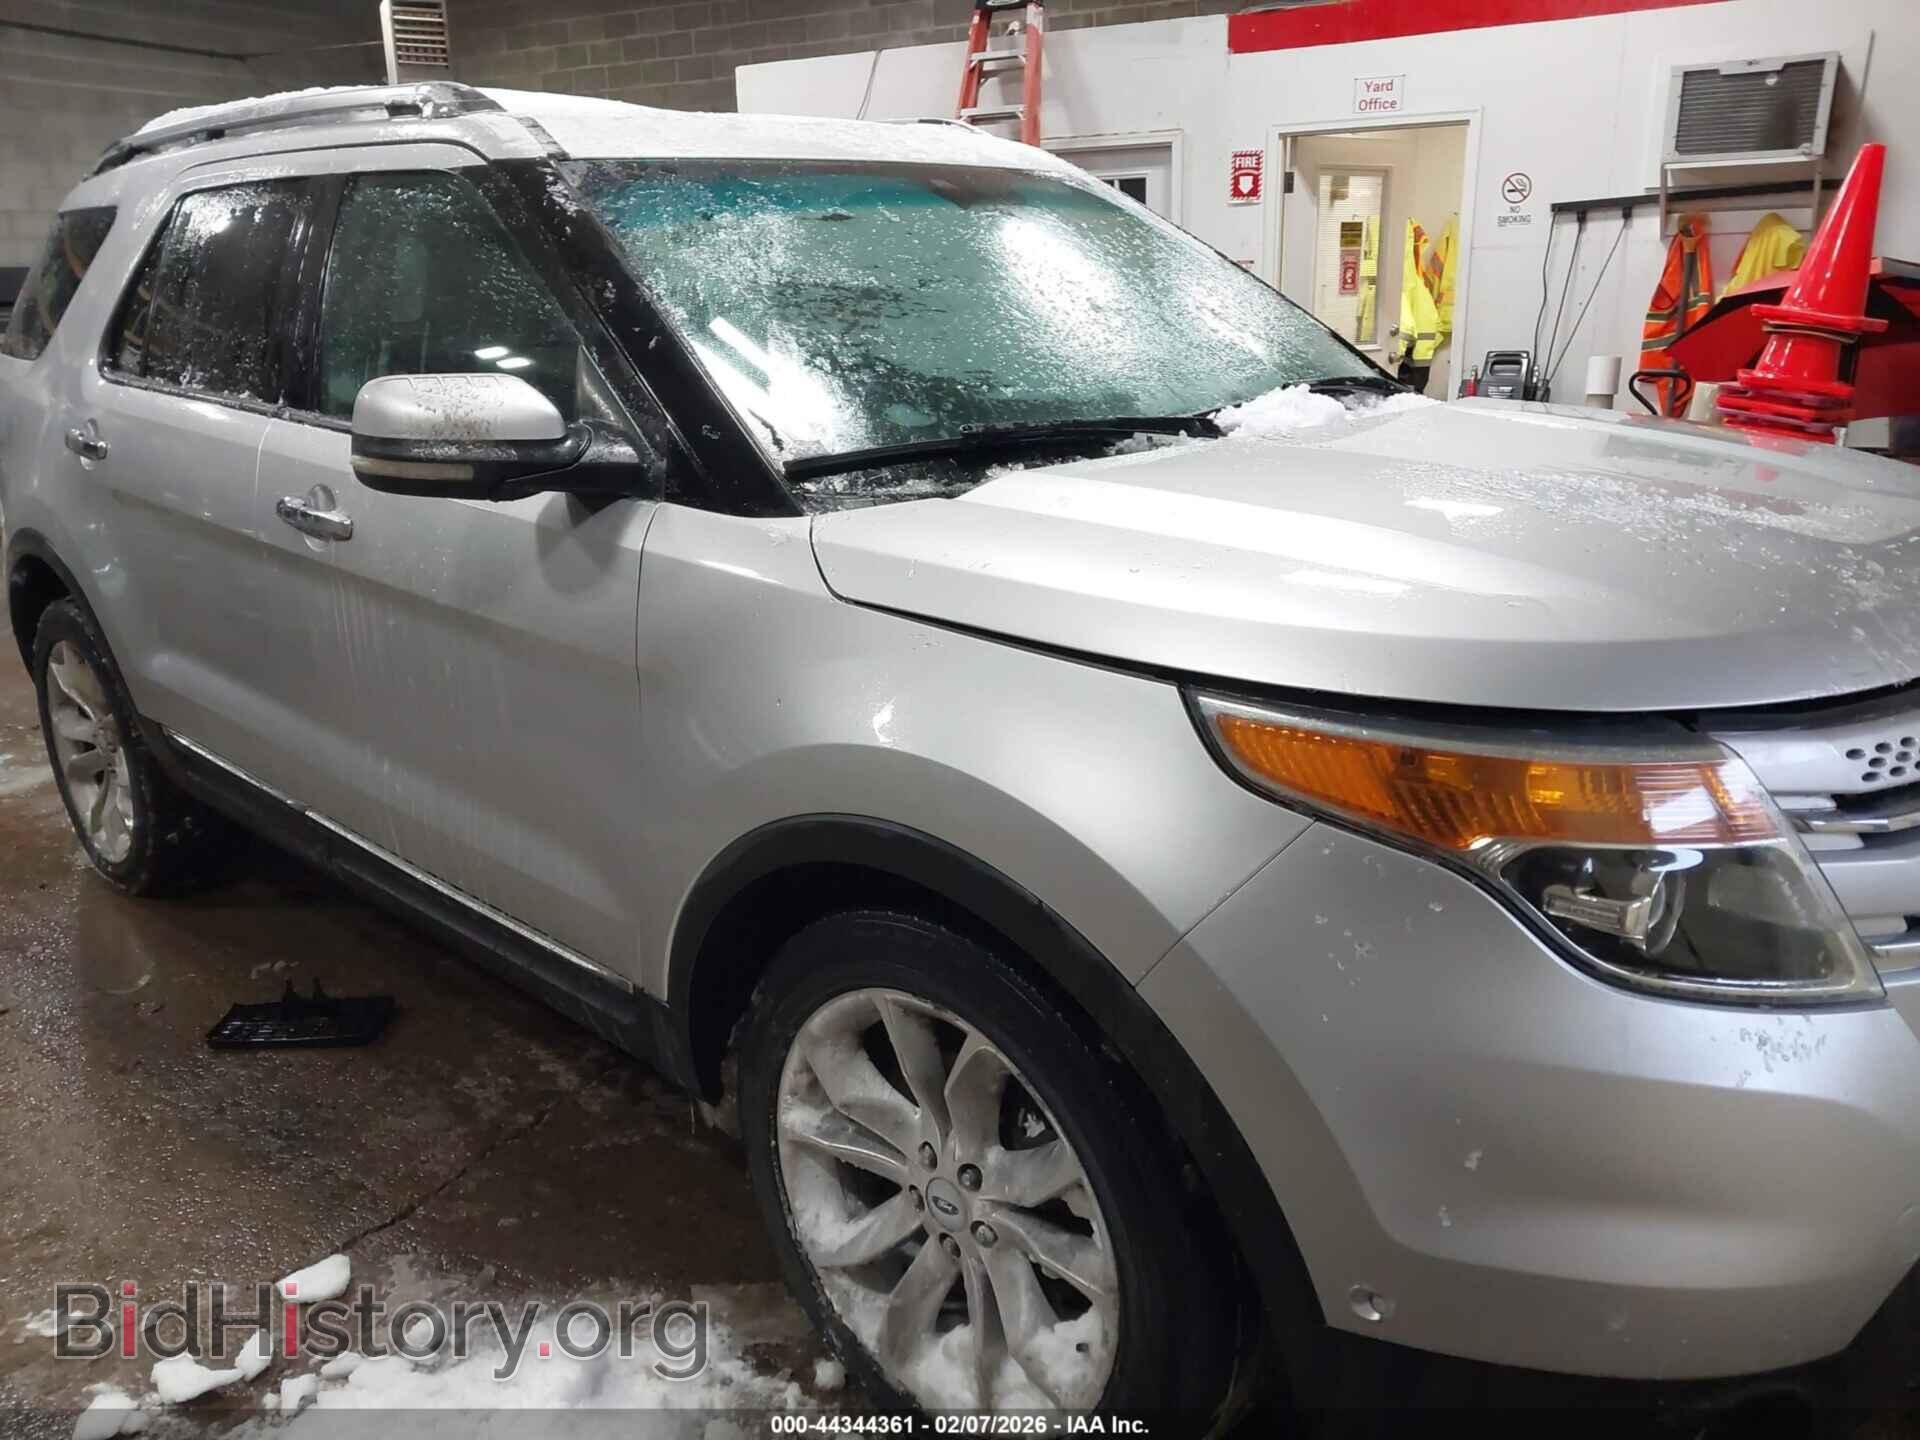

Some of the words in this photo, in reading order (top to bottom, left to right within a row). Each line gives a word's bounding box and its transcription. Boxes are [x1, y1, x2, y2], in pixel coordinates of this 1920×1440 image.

[1365, 79, 1393, 93] Yard
[1358, 98, 1397, 111] Office
[1235, 157, 1259, 168] FIRE
